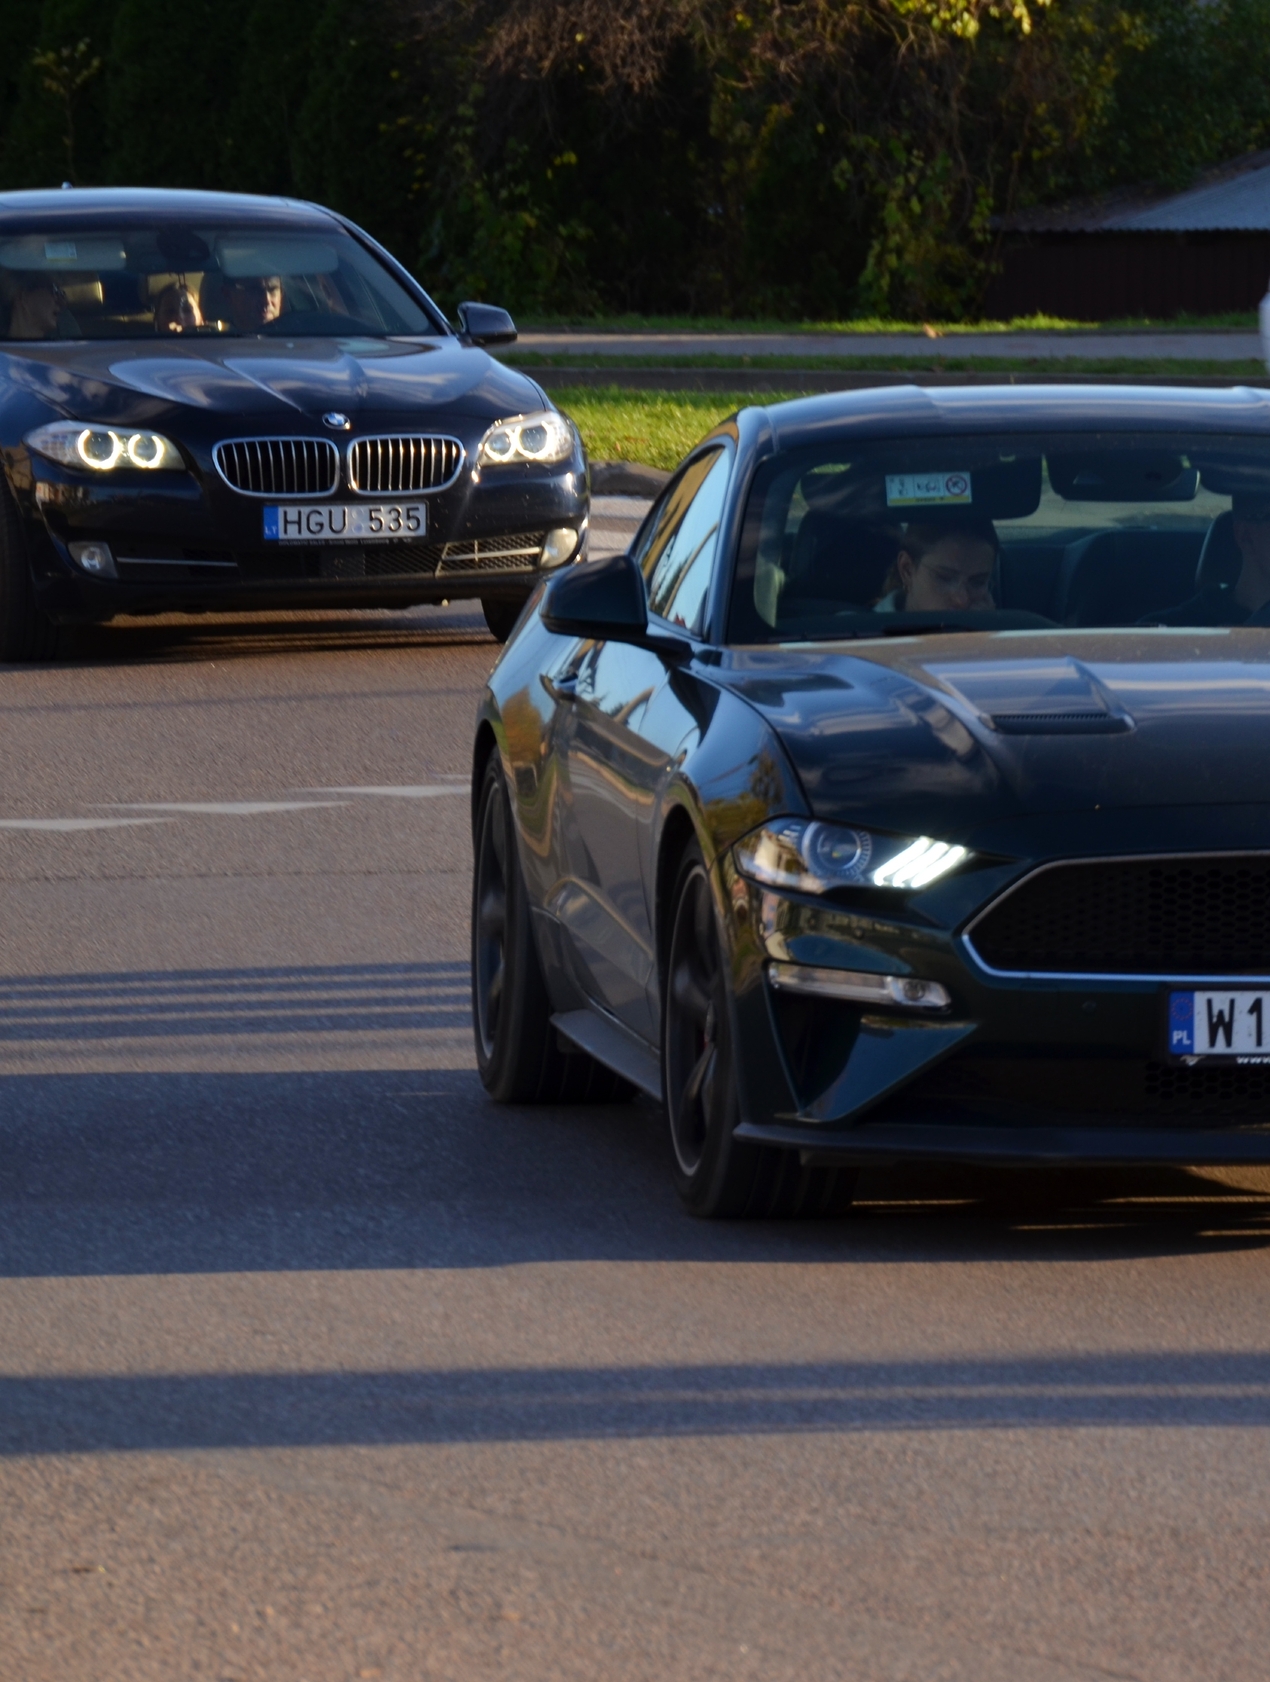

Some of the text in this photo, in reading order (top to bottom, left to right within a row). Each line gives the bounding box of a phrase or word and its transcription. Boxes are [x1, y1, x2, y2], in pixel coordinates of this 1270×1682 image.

[264, 525, 277, 535] LT
[283, 506, 421, 535] HGU 535
[1206, 997, 1263, 1049] W1
[1172, 1030, 1191, 1045] PL
